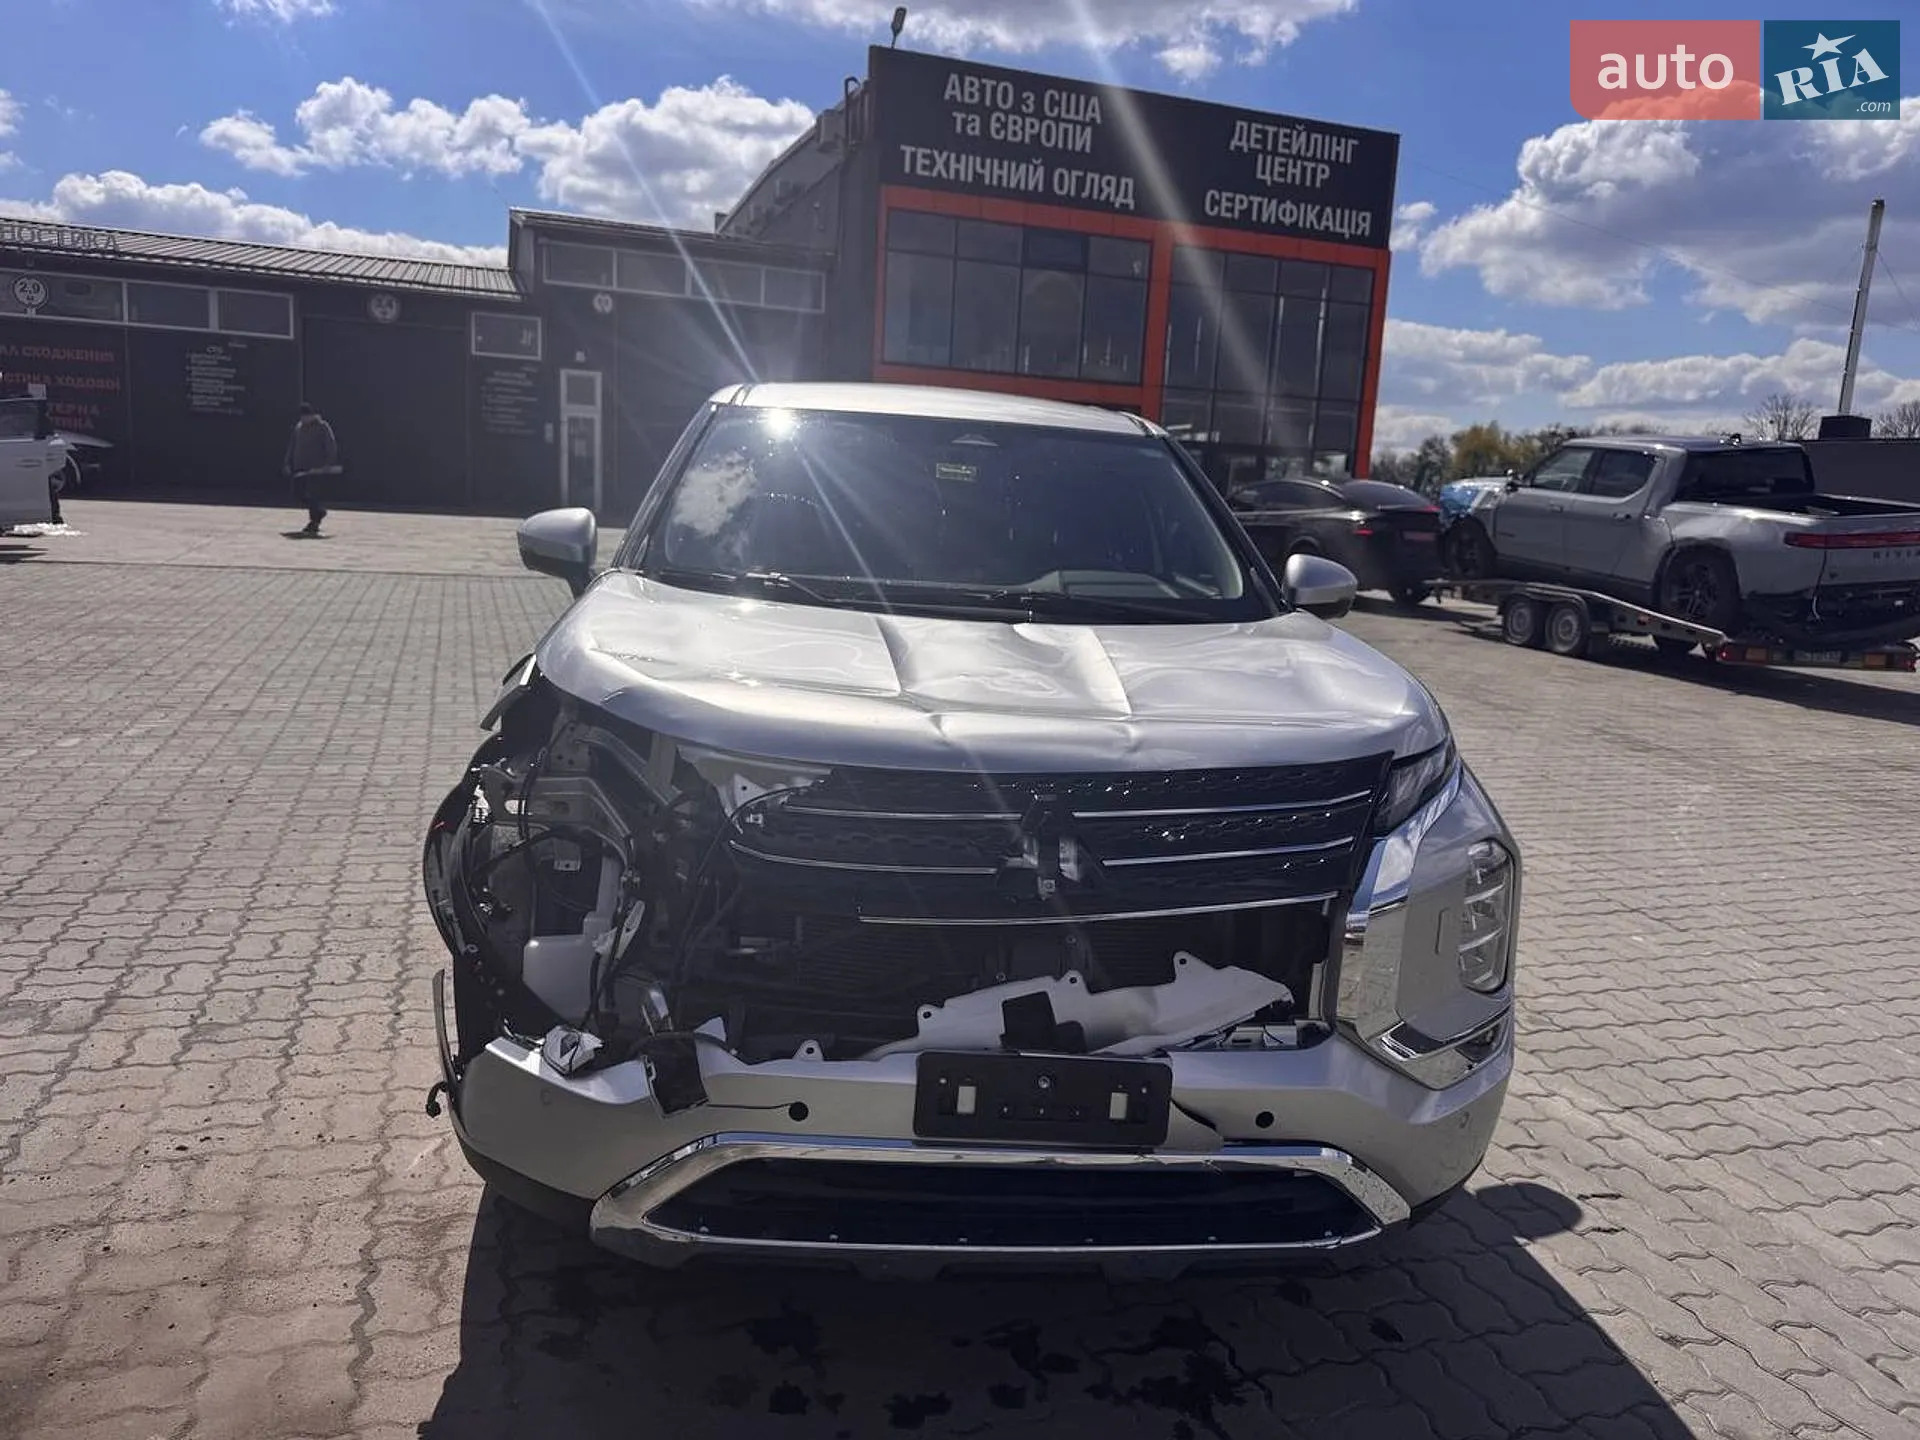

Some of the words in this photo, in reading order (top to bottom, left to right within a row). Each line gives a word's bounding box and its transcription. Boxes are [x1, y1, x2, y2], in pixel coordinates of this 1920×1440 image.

[944, 72, 1013, 111] АВТО
[1021, 90, 1034, 113] з
[1043, 88, 1102, 124] США
[952, 112, 980, 137] та
[990, 111, 1093, 153] ЄВРОПИ
[1229, 120, 1360, 164] ДЕТЕЙЛІНГ
[900, 144, 1044, 193] ТЕХНІЧНИЙ
[1052, 168, 1135, 210] ОГЛЯД
[1255, 152, 1331, 188] ЦЕНТР
[1204, 189, 1373, 239] СЕРТИФІКАЦІЯ
